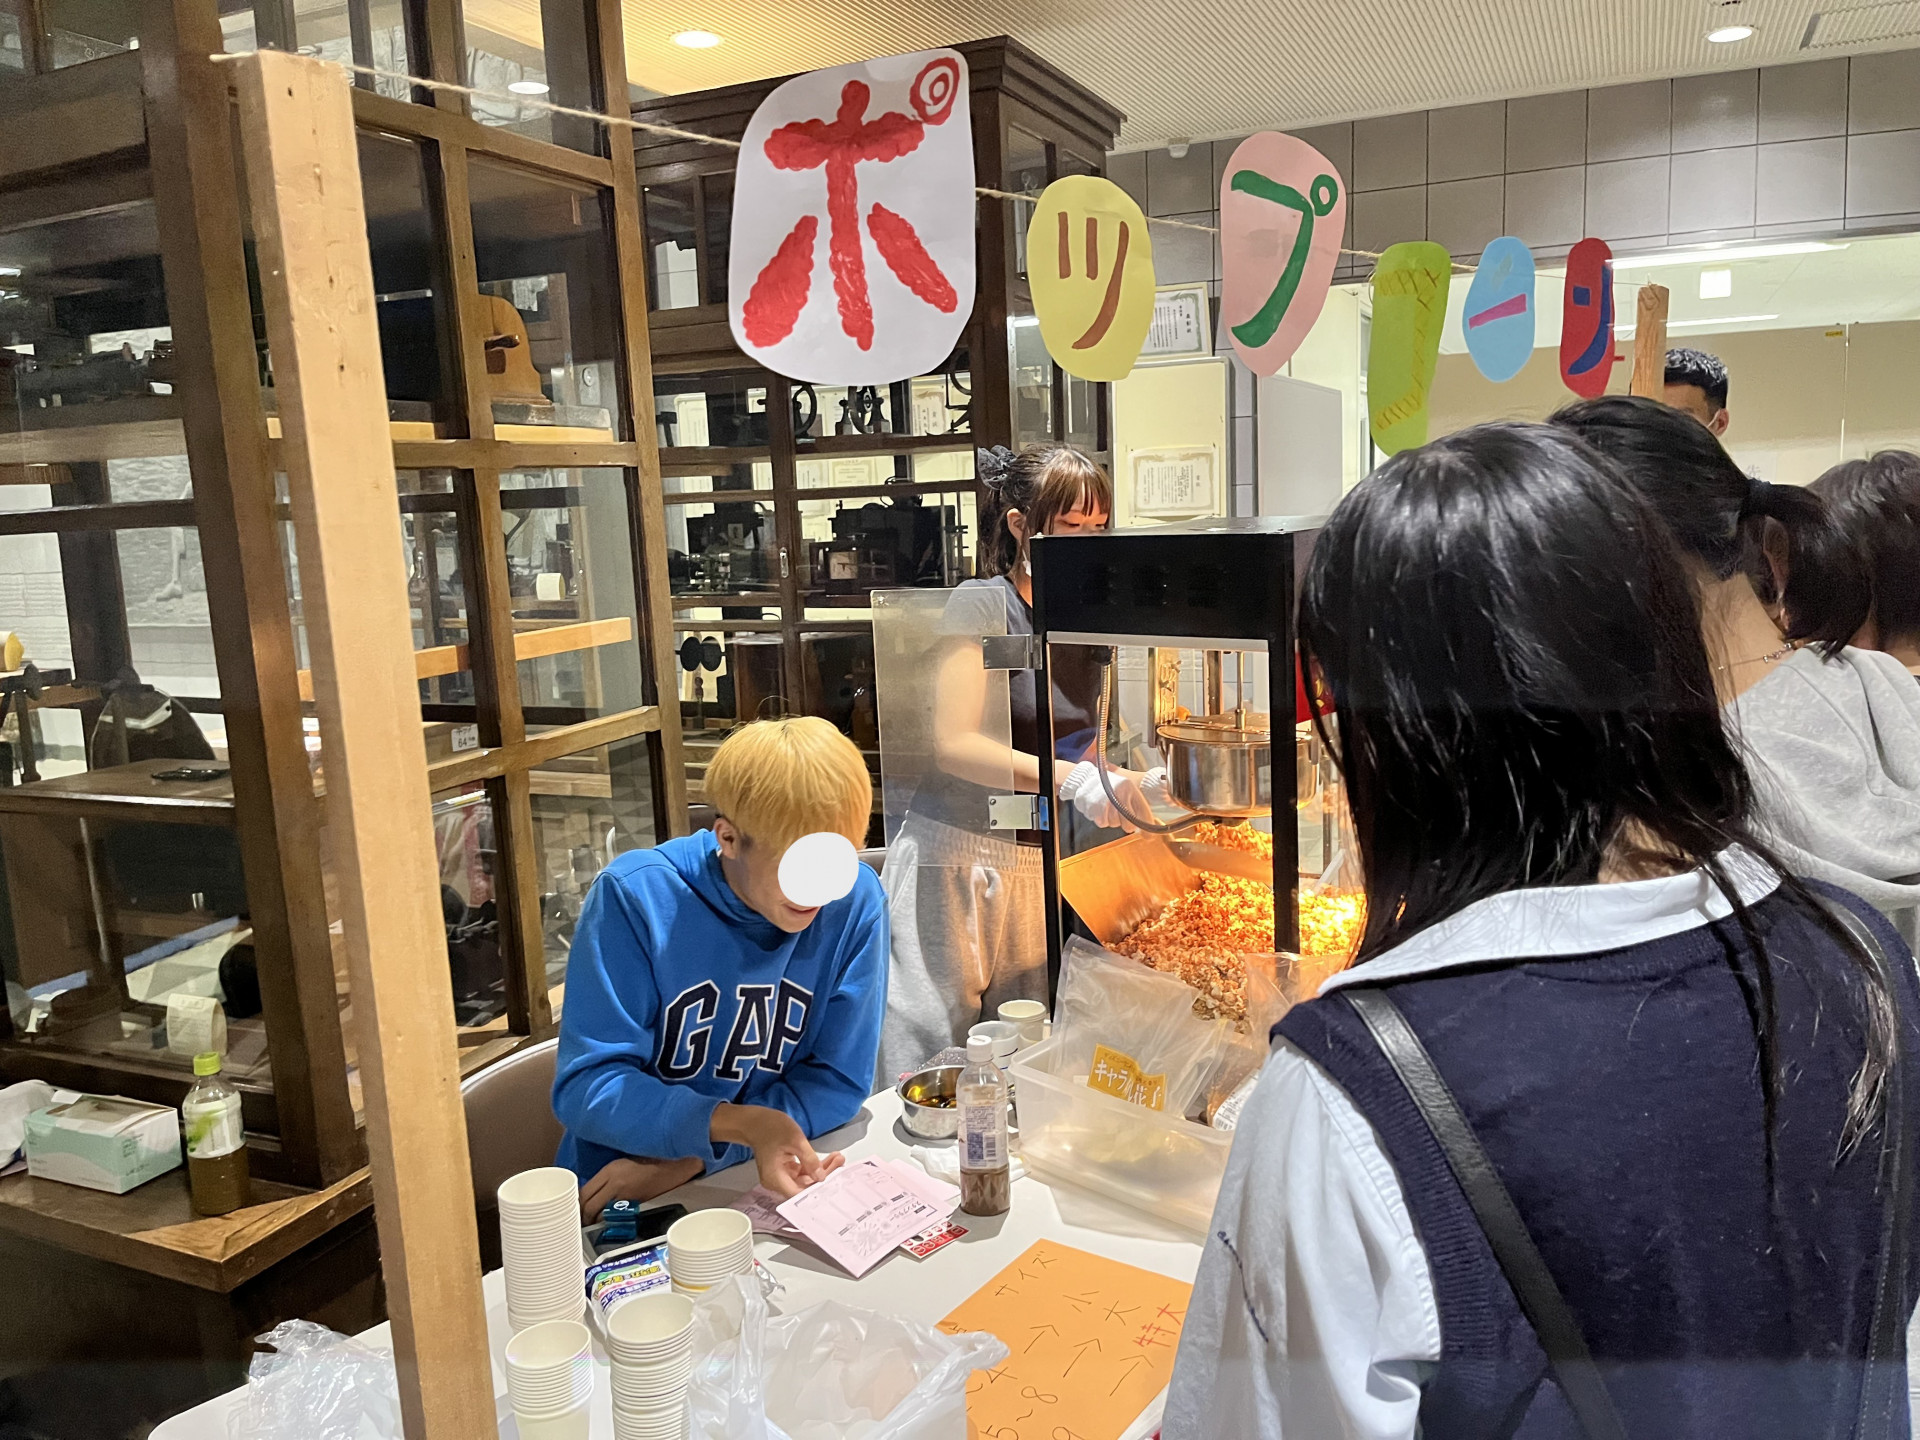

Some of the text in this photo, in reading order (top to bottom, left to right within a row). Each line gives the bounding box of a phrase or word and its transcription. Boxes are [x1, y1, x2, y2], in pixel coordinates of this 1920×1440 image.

[655, 978, 814, 1083] GAP
[994, 1250, 1059, 1297] サイズ
[1103, 1300, 1142, 1327] 大
